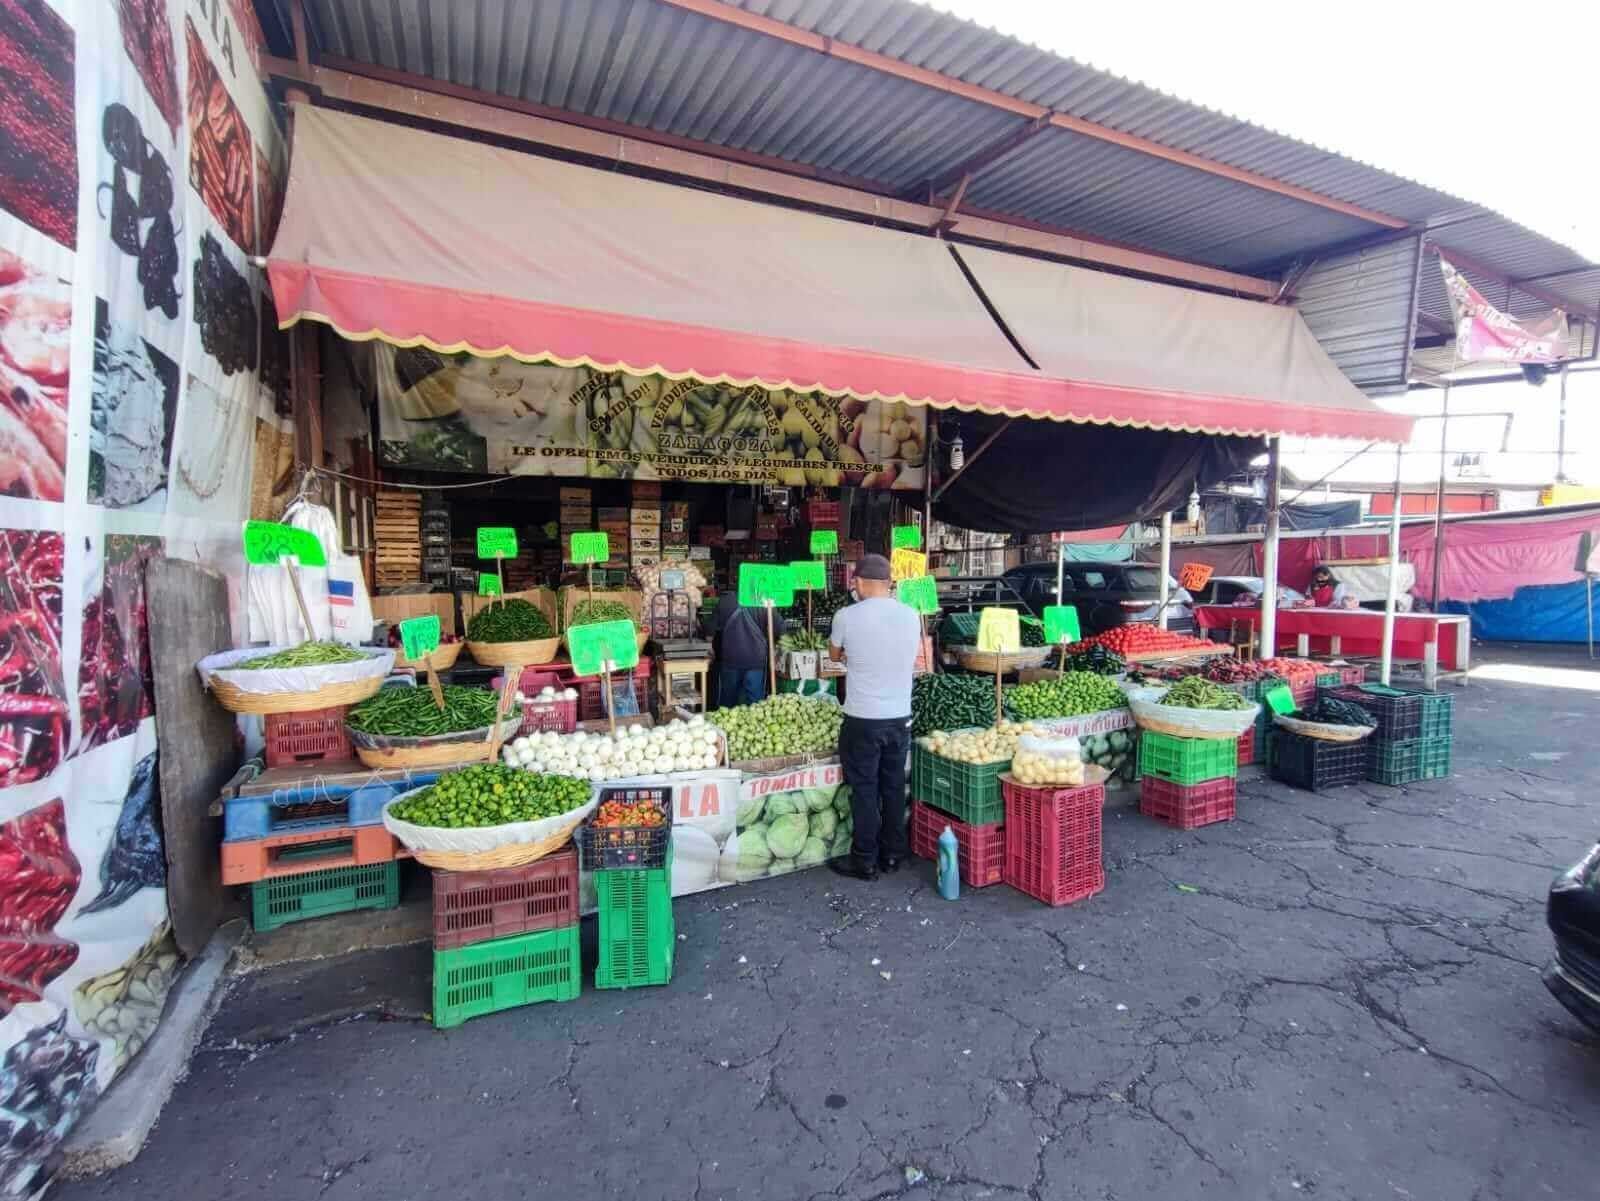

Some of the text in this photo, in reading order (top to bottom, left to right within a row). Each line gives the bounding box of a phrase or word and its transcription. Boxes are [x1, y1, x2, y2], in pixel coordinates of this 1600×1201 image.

[590, 383, 650, 432] CAIDAD!!
[651, 381, 700, 429] VERDUR
[657, 433, 775, 453] ZARAGOZA
[512, 446, 536, 457] LE
[645, 453, 729, 467] VERDURAS
[744, 458, 828, 470] LEGUMBRES
[655, 467, 778, 481] TODOS LOS DIAS
[750, 771, 816, 798] TOMATE
